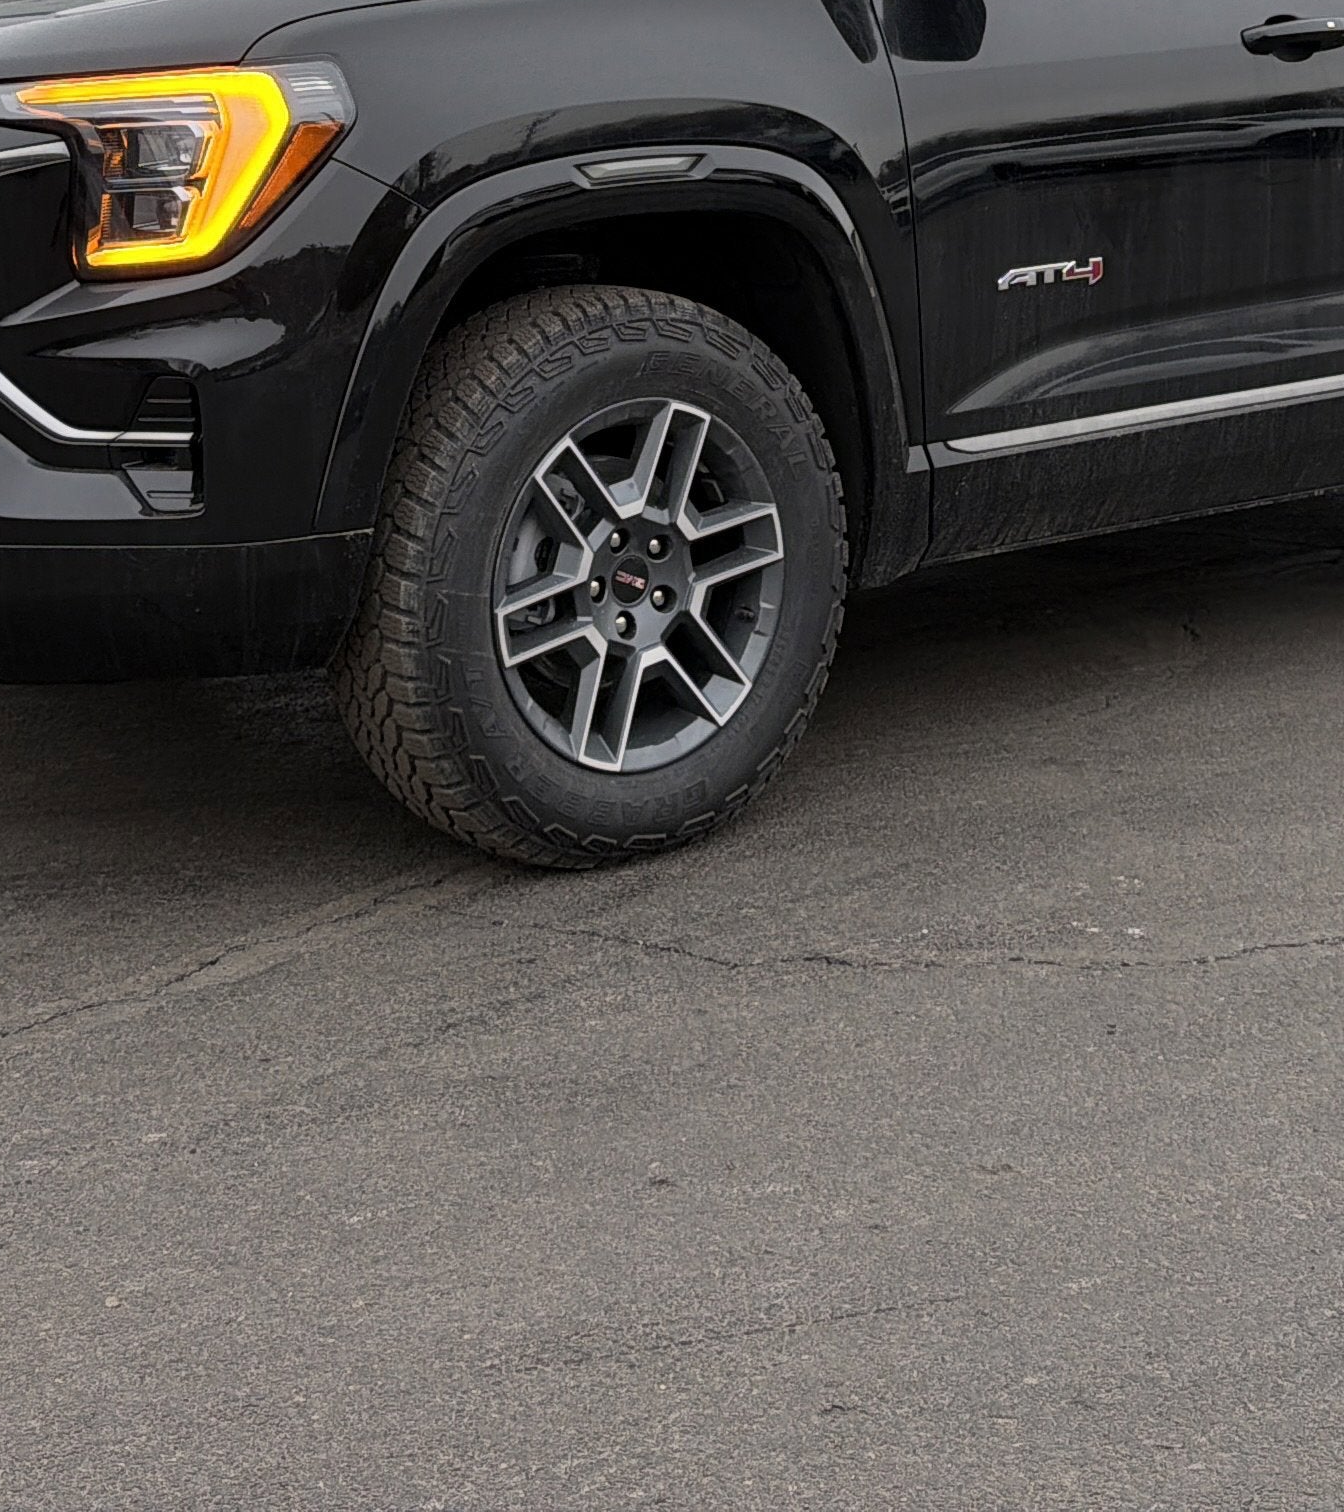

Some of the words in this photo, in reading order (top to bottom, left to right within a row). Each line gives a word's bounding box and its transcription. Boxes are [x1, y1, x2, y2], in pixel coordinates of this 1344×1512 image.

[997, 257, 1104, 291] AT4
[640, 350, 808, 482] GENERAL
[504, 750, 707, 827] GRABBER
